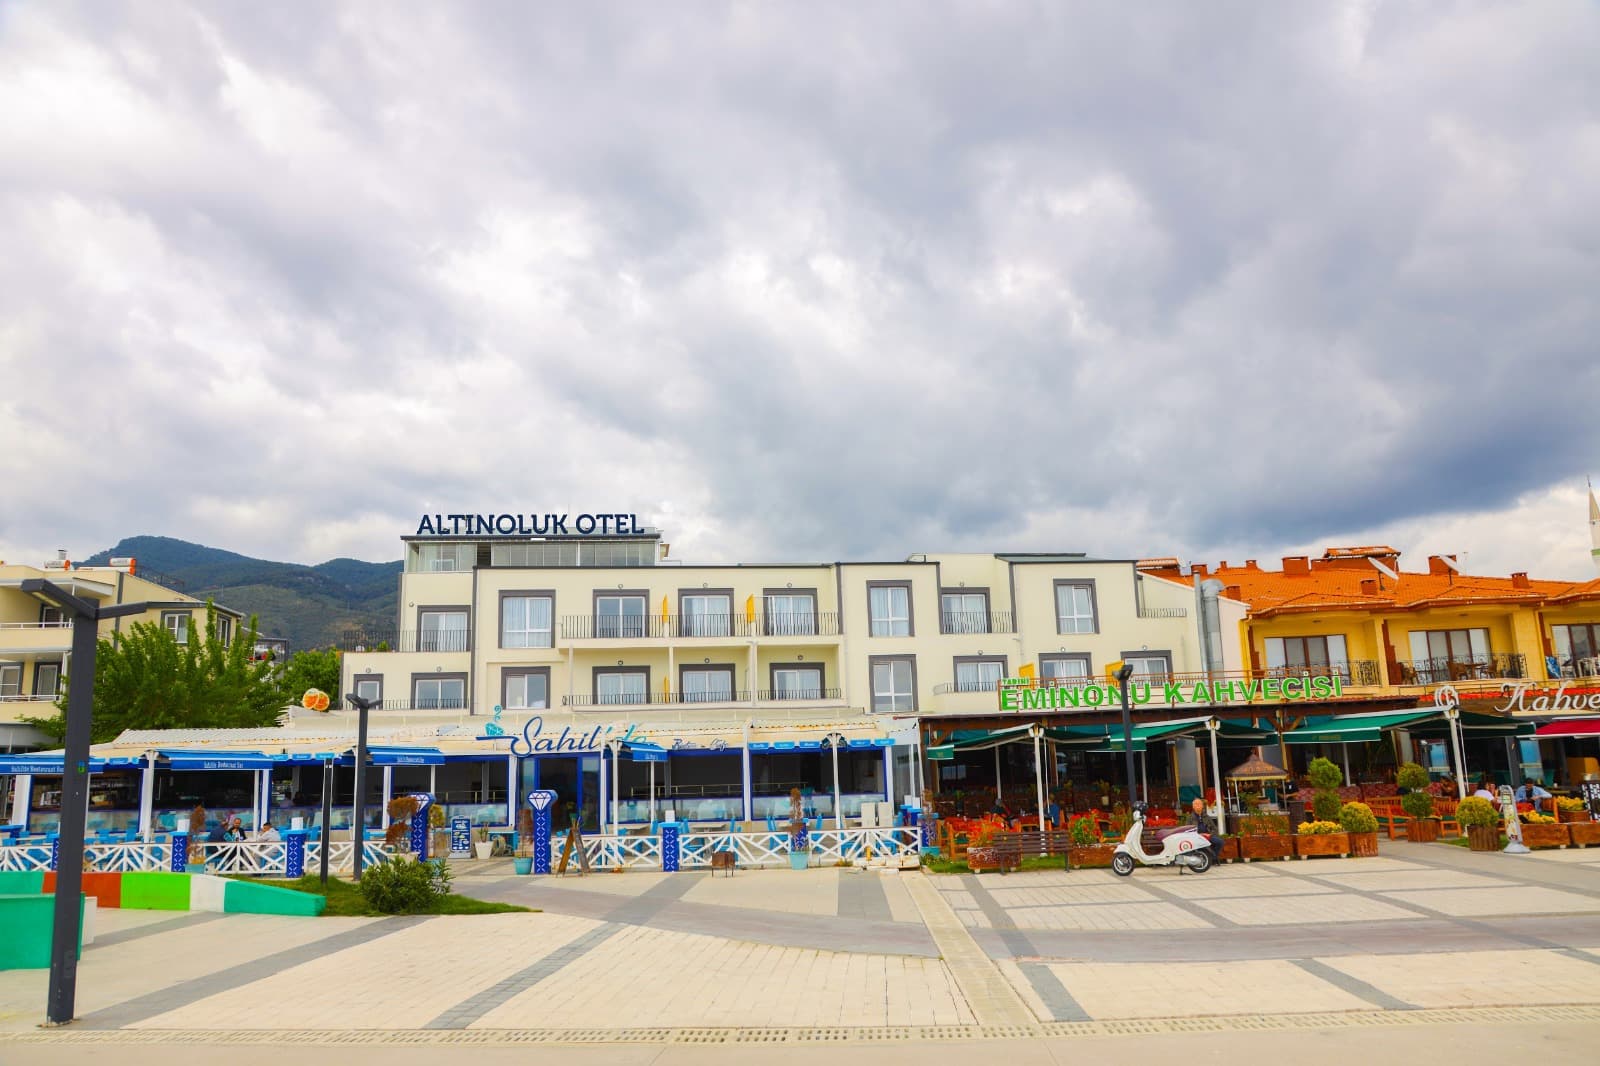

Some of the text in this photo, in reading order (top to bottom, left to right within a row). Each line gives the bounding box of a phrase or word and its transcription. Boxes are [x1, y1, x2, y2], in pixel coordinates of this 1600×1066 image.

[416, 513, 645, 535] ALTINOLUK OTEL
[1163, 671, 1343, 704] KAHVECİSİ
